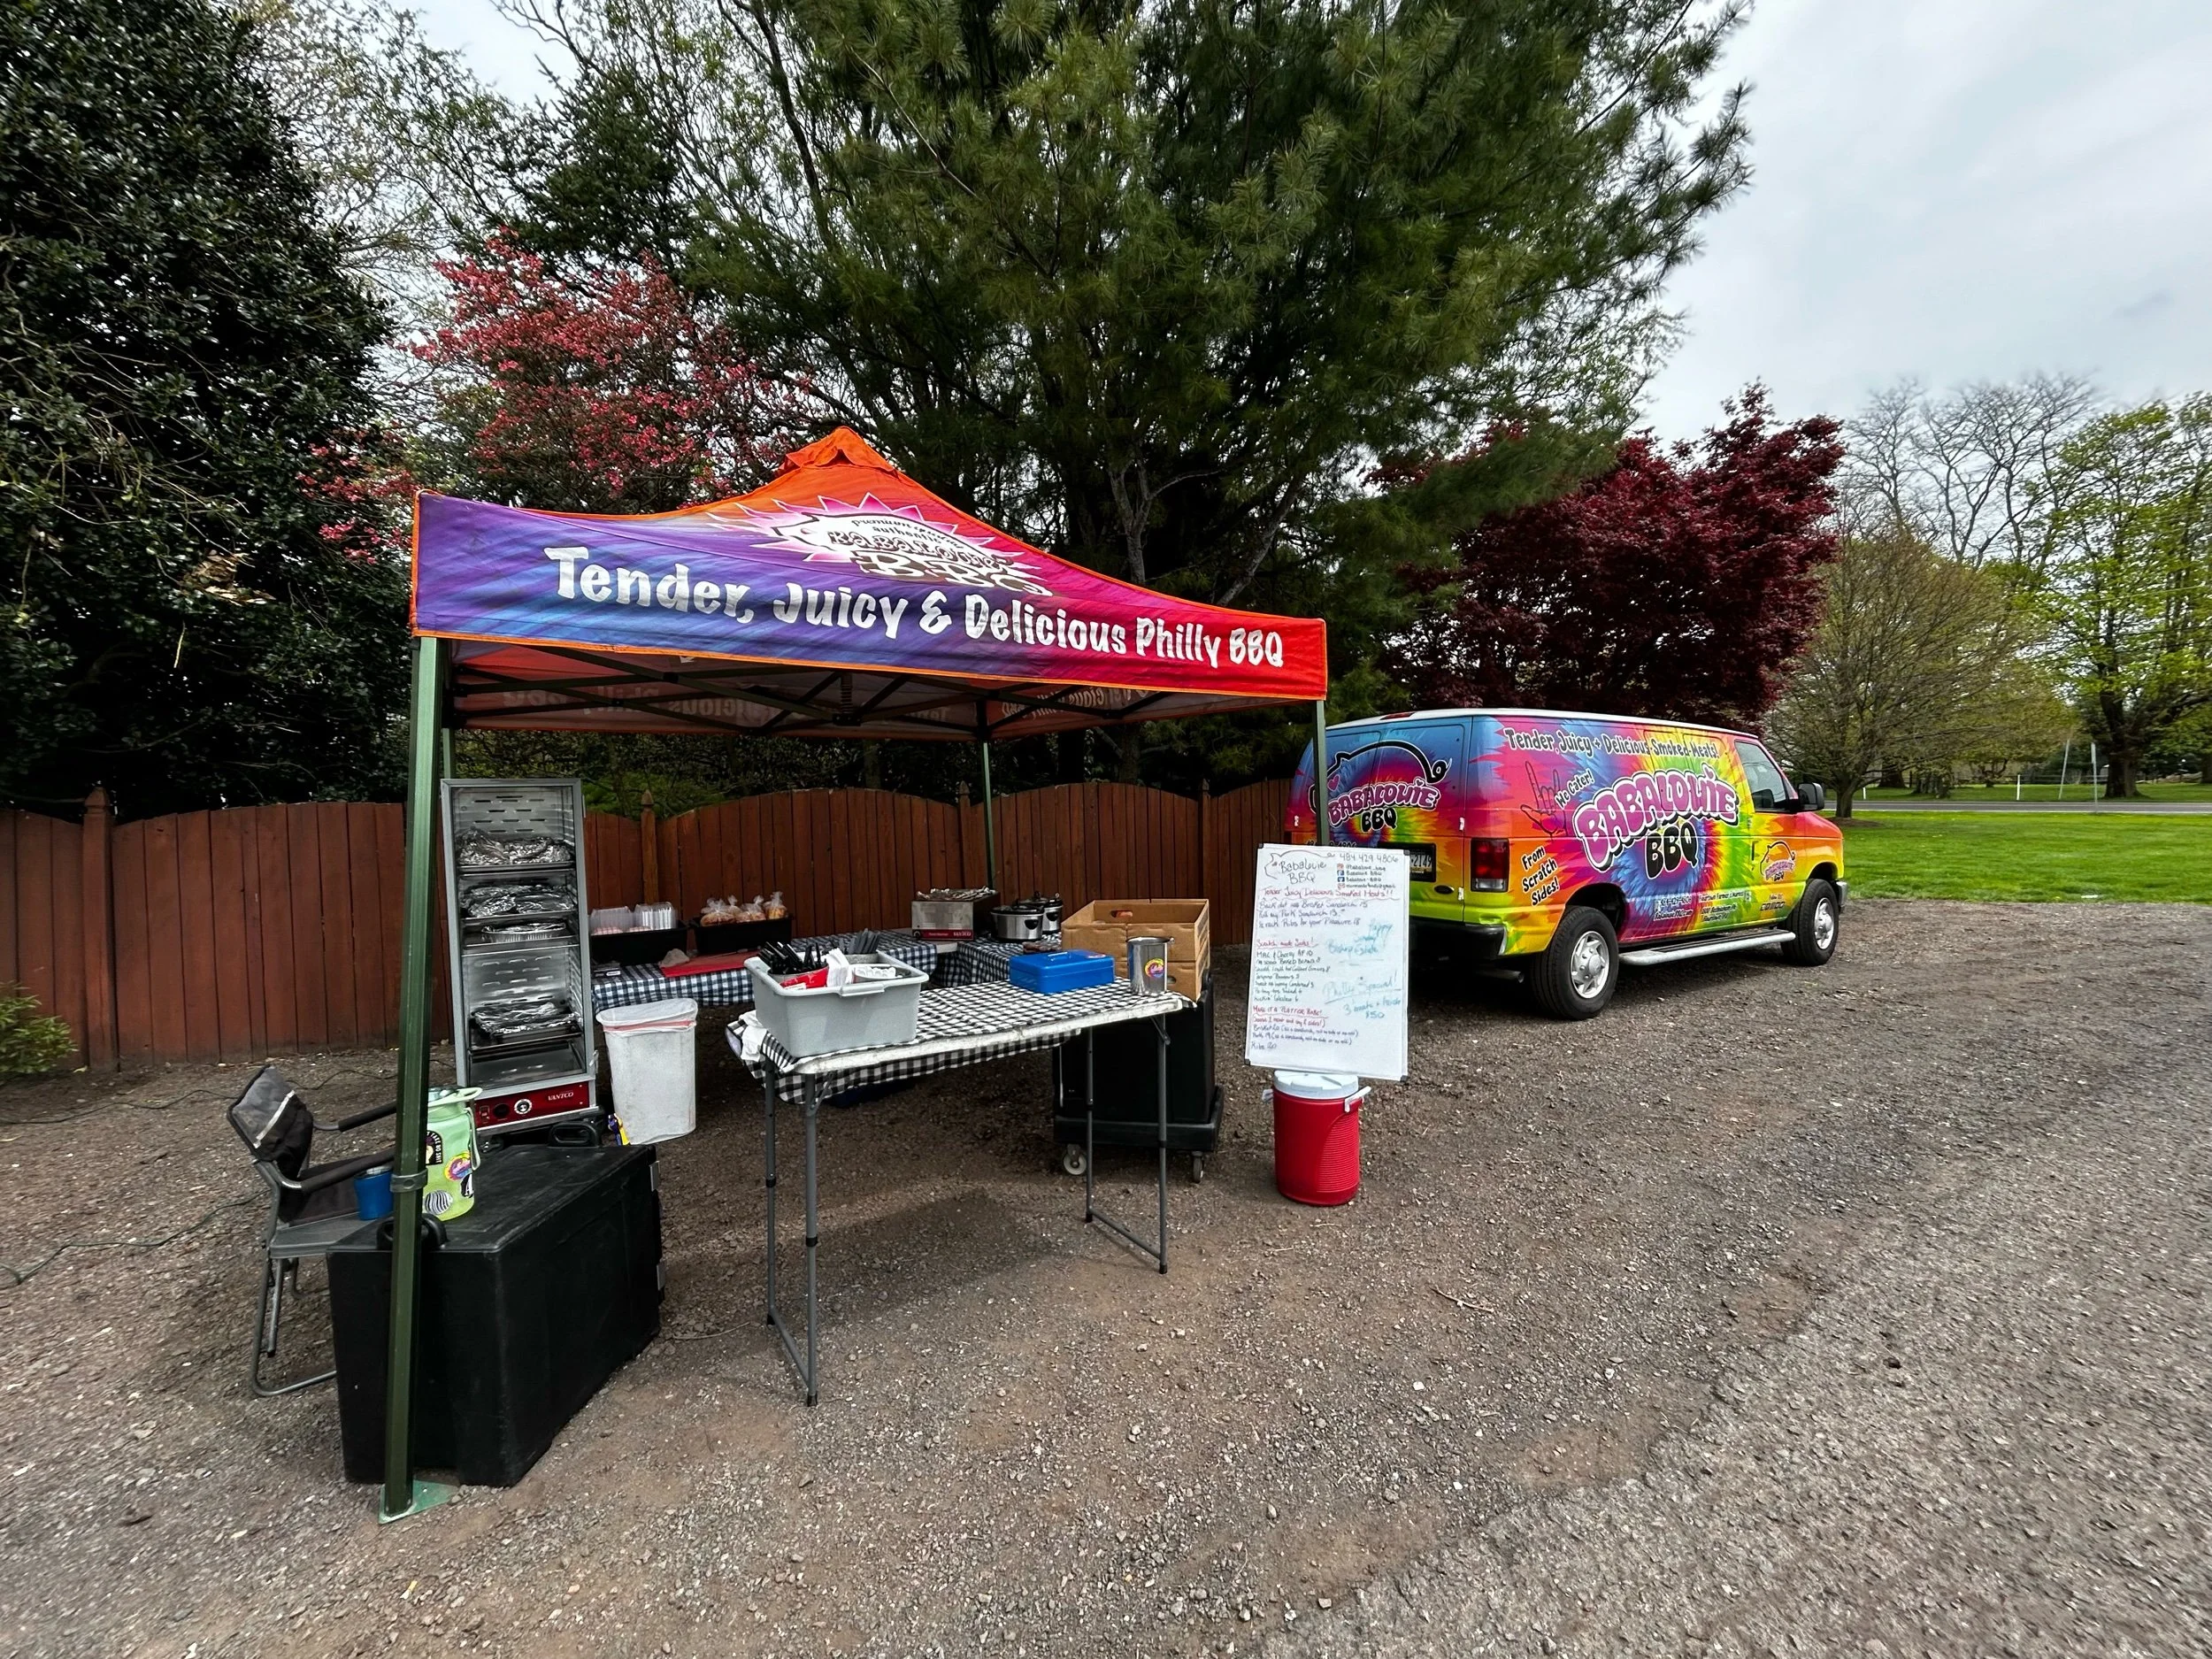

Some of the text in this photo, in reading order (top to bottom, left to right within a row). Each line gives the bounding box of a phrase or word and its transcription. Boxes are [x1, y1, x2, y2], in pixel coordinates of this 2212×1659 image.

[872, 526, 941, 544] authentic
[543, 546, 1284, 669] Tender, Juicy & Delicious Philly BBQ
[1559, 731, 1593, 757] Juicy
[1604, 733, 1650, 756] Delicious
[1328, 777, 1440, 826] BABALOUIE
[1555, 770, 1595, 809] We Cater!
[1362, 807, 1397, 832] BBQ
[1573, 762, 1740, 873] BABALOUIE
[1340, 853, 1399, 864] 484 429 4806
[1521, 846, 1546, 872] From
[1645, 819, 1699, 879] BBQ
[1287, 872, 1316, 885] BBQ
[1522, 857, 1558, 894] Scratch
[1531, 876, 1560, 906] Sides!
